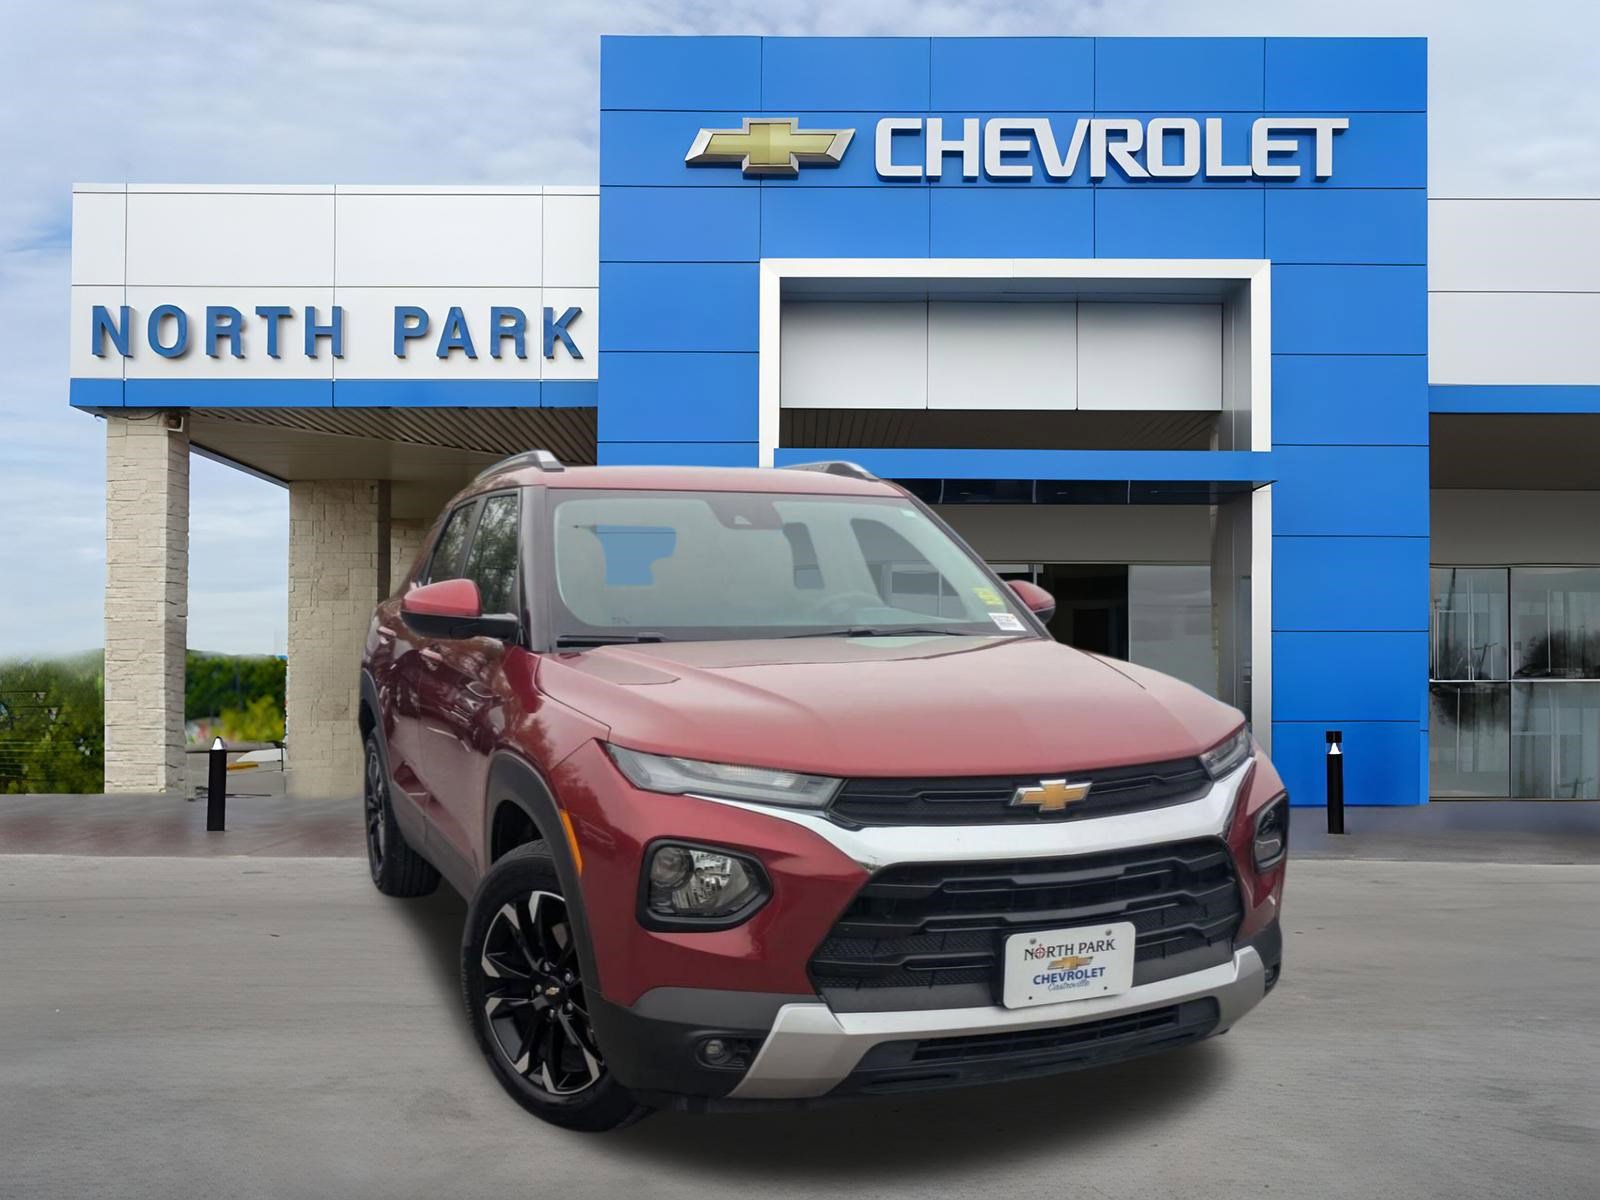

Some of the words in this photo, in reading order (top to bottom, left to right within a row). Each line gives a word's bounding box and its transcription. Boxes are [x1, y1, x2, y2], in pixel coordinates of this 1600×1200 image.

[875, 117, 1349, 179] CHEVROLET
[92, 305, 345, 359] NORTH
[394, 306, 584, 360] PARK
[1024, 944, 1074, 961] NORTH
[1078, 939, 1116, 955] PARK
[1033, 967, 1106, 985] CHEVROLET
